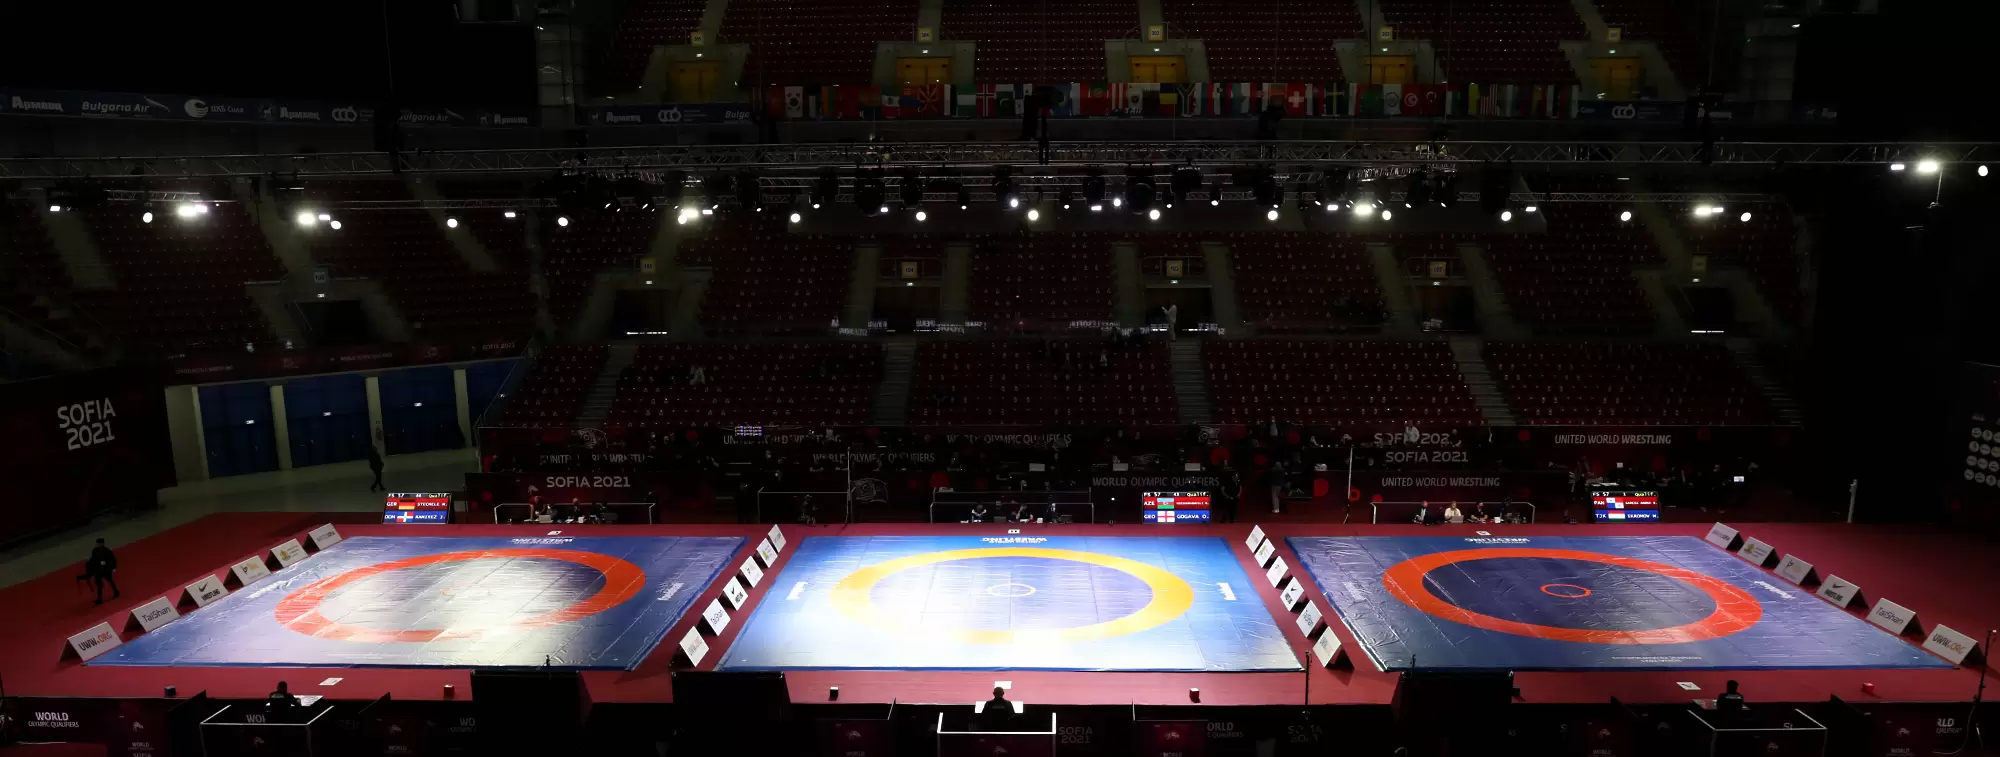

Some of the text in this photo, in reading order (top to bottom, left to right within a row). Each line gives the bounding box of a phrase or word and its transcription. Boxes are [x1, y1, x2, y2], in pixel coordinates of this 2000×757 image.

[82, 100, 150, 113] Bulgaria Air
[57, 396, 117, 430] SOFIA
[65, 420, 117, 451] 2021
[1554, 434, 1673, 445] UNITED WORLD WRESTLING
[1385, 451, 1469, 464] SOFIA 2021
[546, 476, 632, 488] SOFIA 2021
[1092, 477, 1128, 488] WORLD
[1130, 477, 1169, 488] OLYMPIC
[1381, 476, 1501, 488] UNITED WORLD WRESTLING
[142, 606, 172, 624] TaiShan
[1876, 606, 1904, 625] TaiShan
[78, 631, 113, 653] UWW.ORG
[1932, 633, 1965, 654] UWW.ORG
[35, 711, 69, 722] WORLD
[1058, 726, 1093, 736] SOFIA
[1060, 735, 1092, 744] 2021
